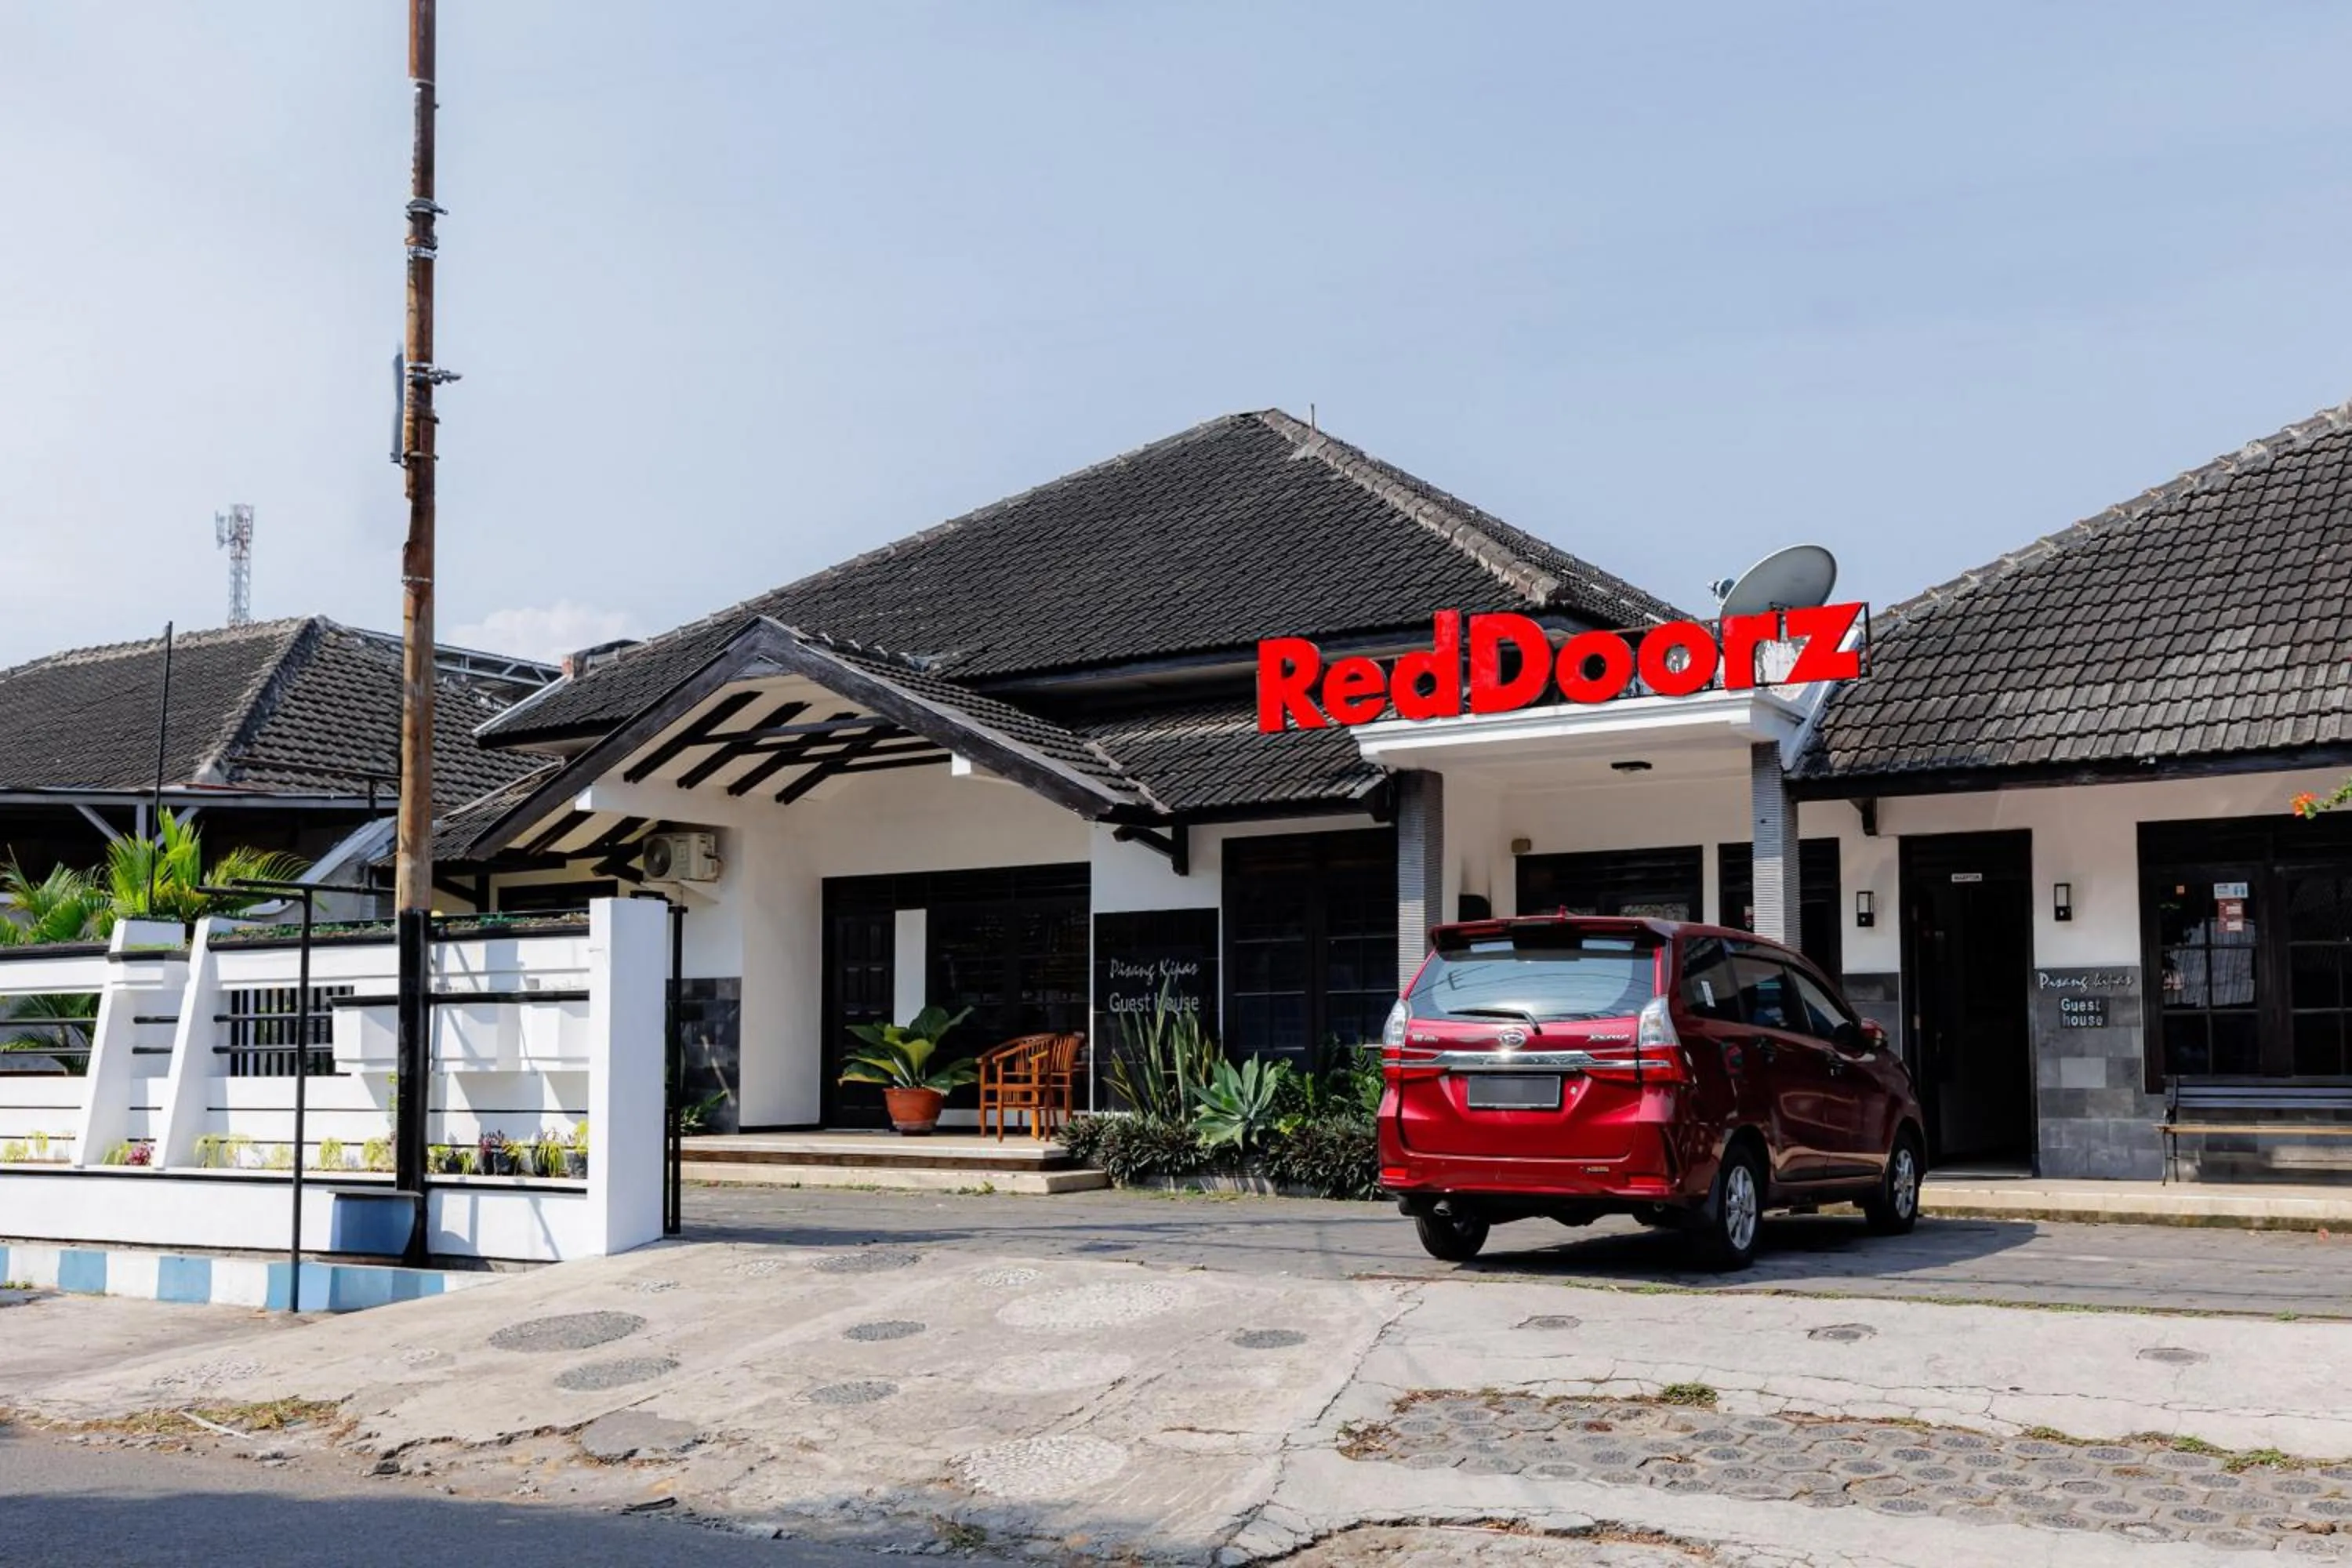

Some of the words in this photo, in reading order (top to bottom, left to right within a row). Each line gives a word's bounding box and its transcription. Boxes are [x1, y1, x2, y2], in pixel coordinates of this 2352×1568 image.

[1258, 602, 1860, 734] RedDoorz
[1110, 957, 1155, 986] Pisang
[2039, 971, 2088, 993] Pisang
[1109, 992, 1151, 1013] Guest
[2060, 997, 2101, 1012] Guest
[2063, 1013, 2103, 1027] house
